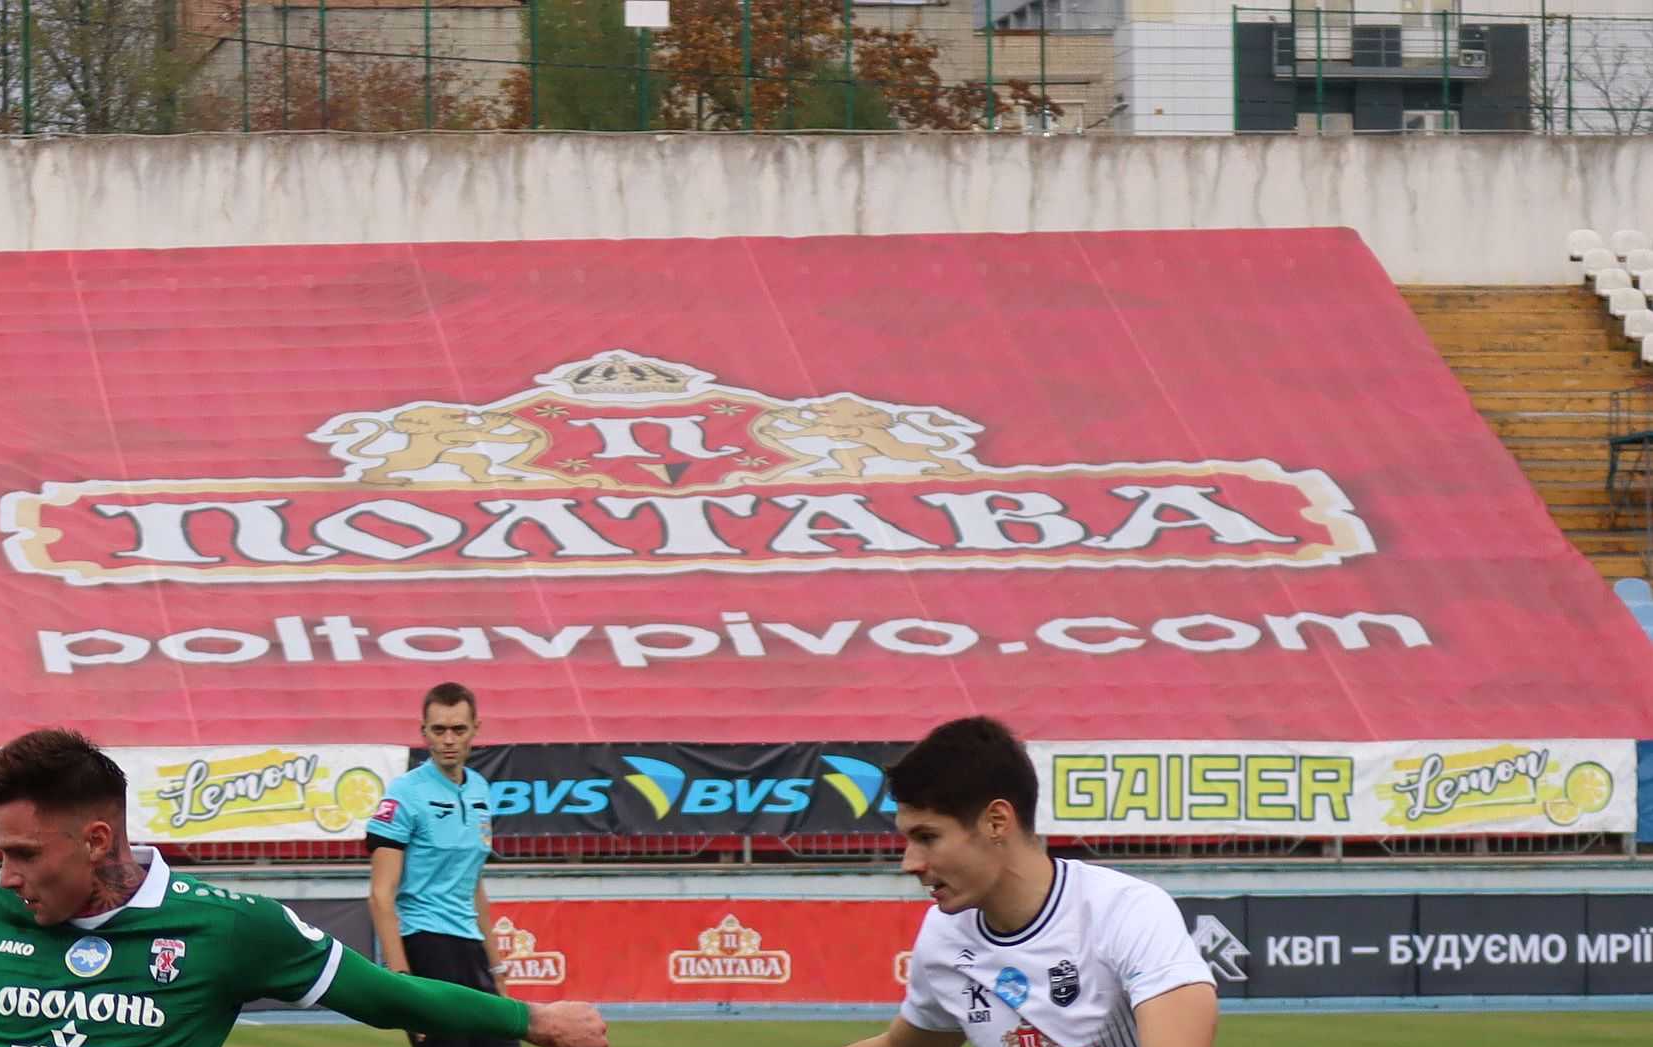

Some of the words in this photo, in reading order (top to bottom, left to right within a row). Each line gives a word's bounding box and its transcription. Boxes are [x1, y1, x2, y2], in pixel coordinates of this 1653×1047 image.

[91, 484, 1297, 563] ПОЛТАВА
[37, 611, 1432, 674] poltavpivo.com
[157, 754, 318, 828] Lemon
[492, 779, 613, 815] BVS
[681, 778, 816, 814] BVS
[1052, 754, 1354, 821] GAISER
[1394, 748, 1550, 821] Lemon
[679, 957, 783, 977] ПОЛТАВА
[1266, 935, 1341, 966] КВП
[1388, 934, 1567, 970] БУДУЄМО
